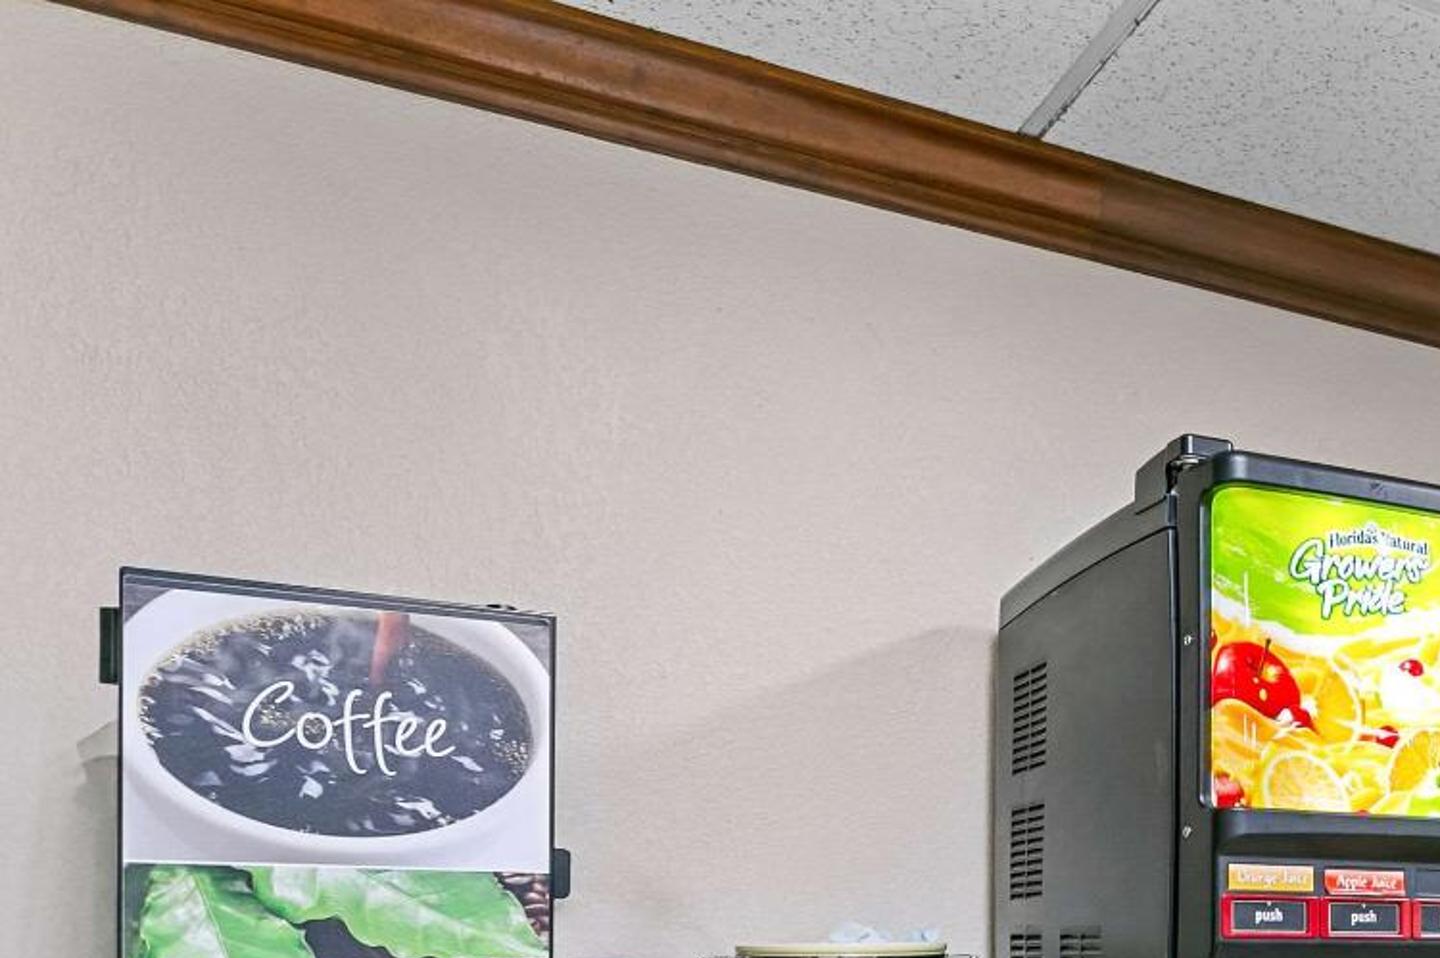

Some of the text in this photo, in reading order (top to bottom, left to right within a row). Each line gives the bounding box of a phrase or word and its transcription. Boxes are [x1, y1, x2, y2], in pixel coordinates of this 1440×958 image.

[1315, 578, 1408, 621] Pride
[242, 681, 456, 775] Coffee
[1336, 874, 1397, 890] Apple Juice
[1255, 908, 1283, 924] push
[1351, 911, 1377, 926] push
